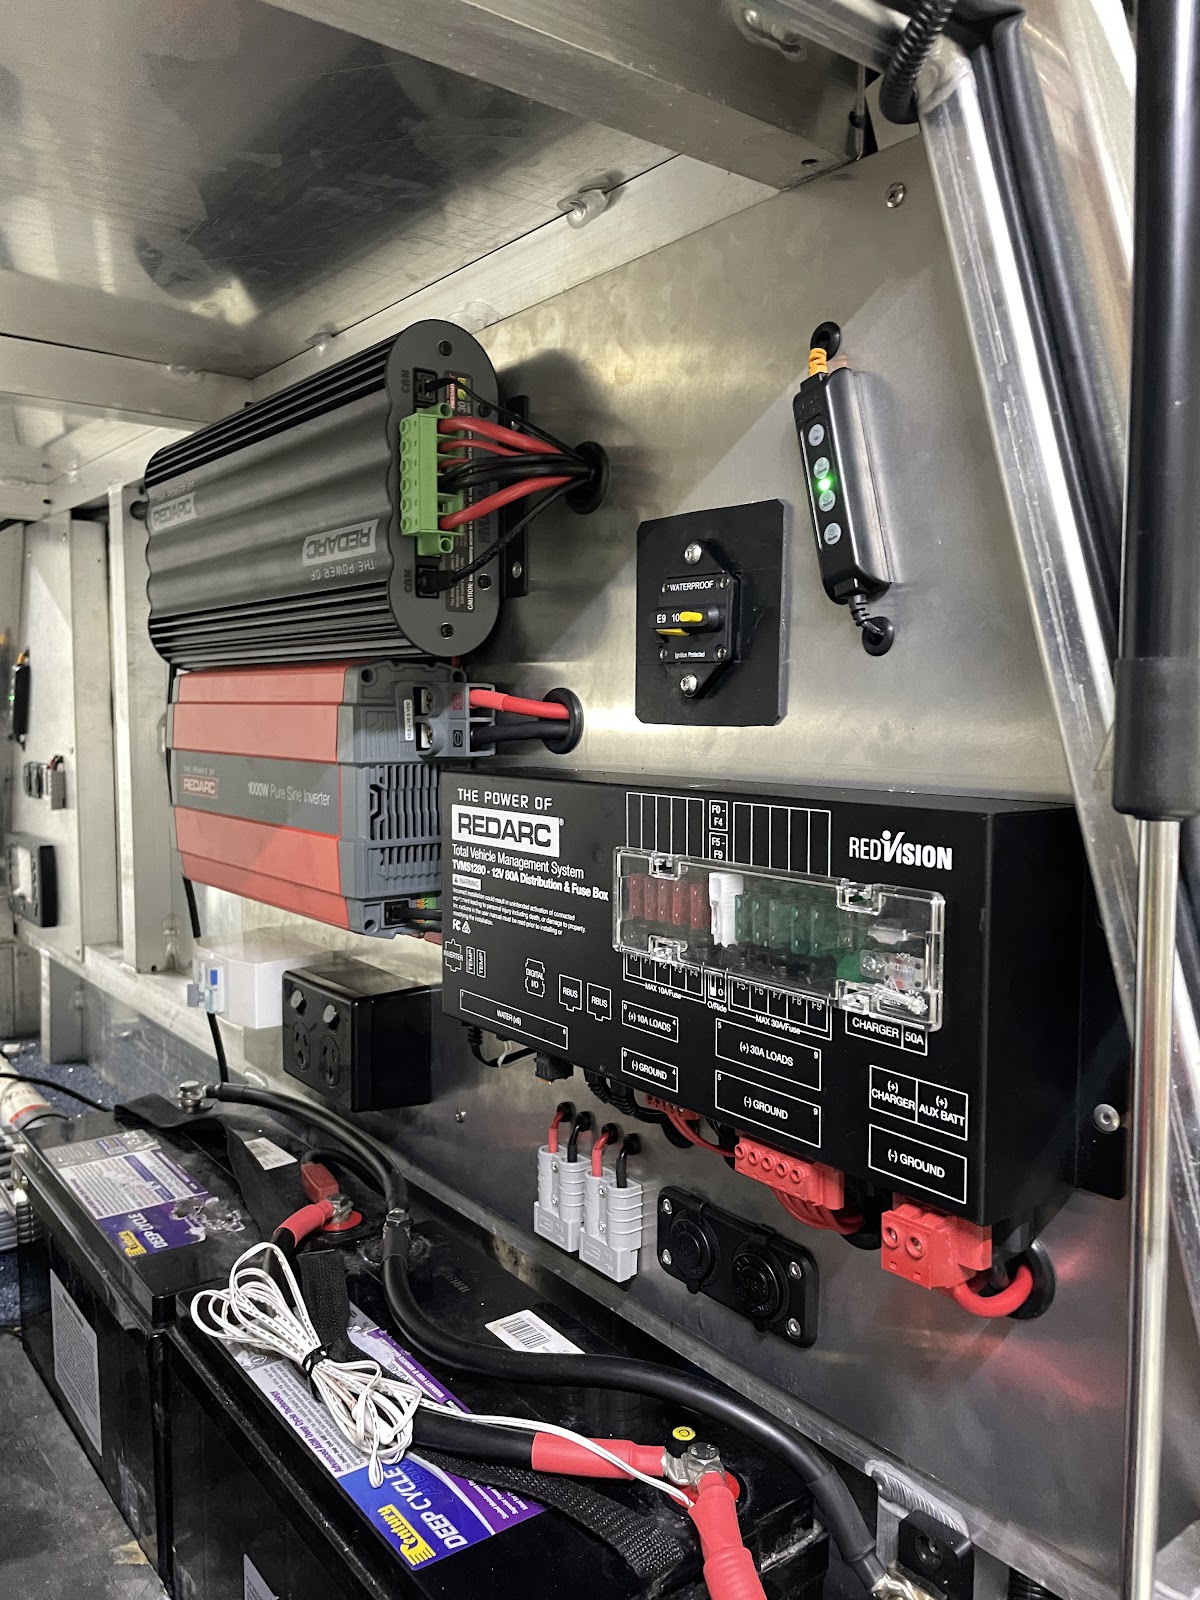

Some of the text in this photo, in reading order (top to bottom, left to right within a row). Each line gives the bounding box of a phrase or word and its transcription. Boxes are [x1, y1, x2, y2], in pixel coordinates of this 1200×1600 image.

[306, 526, 372, 560] REDARC
[311, 559, 375, 581] THE POWER OF
[670, 580, 714, 592] WATERPROOF
[656, 614, 667, 624] E9
[184, 778, 216, 794] REDARC
[248, 782, 330, 806] 1000W Pure Sine Inverter
[457, 788, 552, 811] THE POWER OF
[458, 812, 551, 848] REDARC
[714, 816, 724, 826] F4
[452, 844, 584, 880] Total Vehicle Management System
[714, 849, 724, 860] F9
[452, 858, 608, 900] TVMS1280 12V 80A Distribution & Fuse Box
[444, 950, 464, 962] INVERTER
[526, 968, 544, 980] DIGITAL
[562, 986, 578, 998] RBUS
[644, 982, 682, 1000] MAX 10A/Fuse
[591, 996, 608, 1008] RBUS
[707, 1001, 728, 1014] O/Ride
[496, 1010, 513, 1022] WATER
[637, 1014, 649, 1026] 10A
[649, 1018, 672, 1032] LOADS
[756, 1014, 800, 1034] MAX 30A/Fuse
[852, 1017, 900, 1038] CHARGER
[904, 1031, 924, 1046] 50A
[750, 1045, 765, 1058] 30A
[766, 1050, 794, 1066] LOADS
[638, 1063, 668, 1080] GROUND
[871, 1088, 916, 1110] CHARGER
[752, 1100, 788, 1120] GROUND
[918, 1104, 966, 1126] AUX BATT
[900, 1153, 946, 1179] GROUND
[128, 1212, 168, 1248] DEEP CYCLE
[270, 1390, 343, 1473] Advanced AGM Deep Cycle Technology
[384, 1466, 468, 1550] DEEP CYCLE
[377, 1506, 419, 1551] Century
